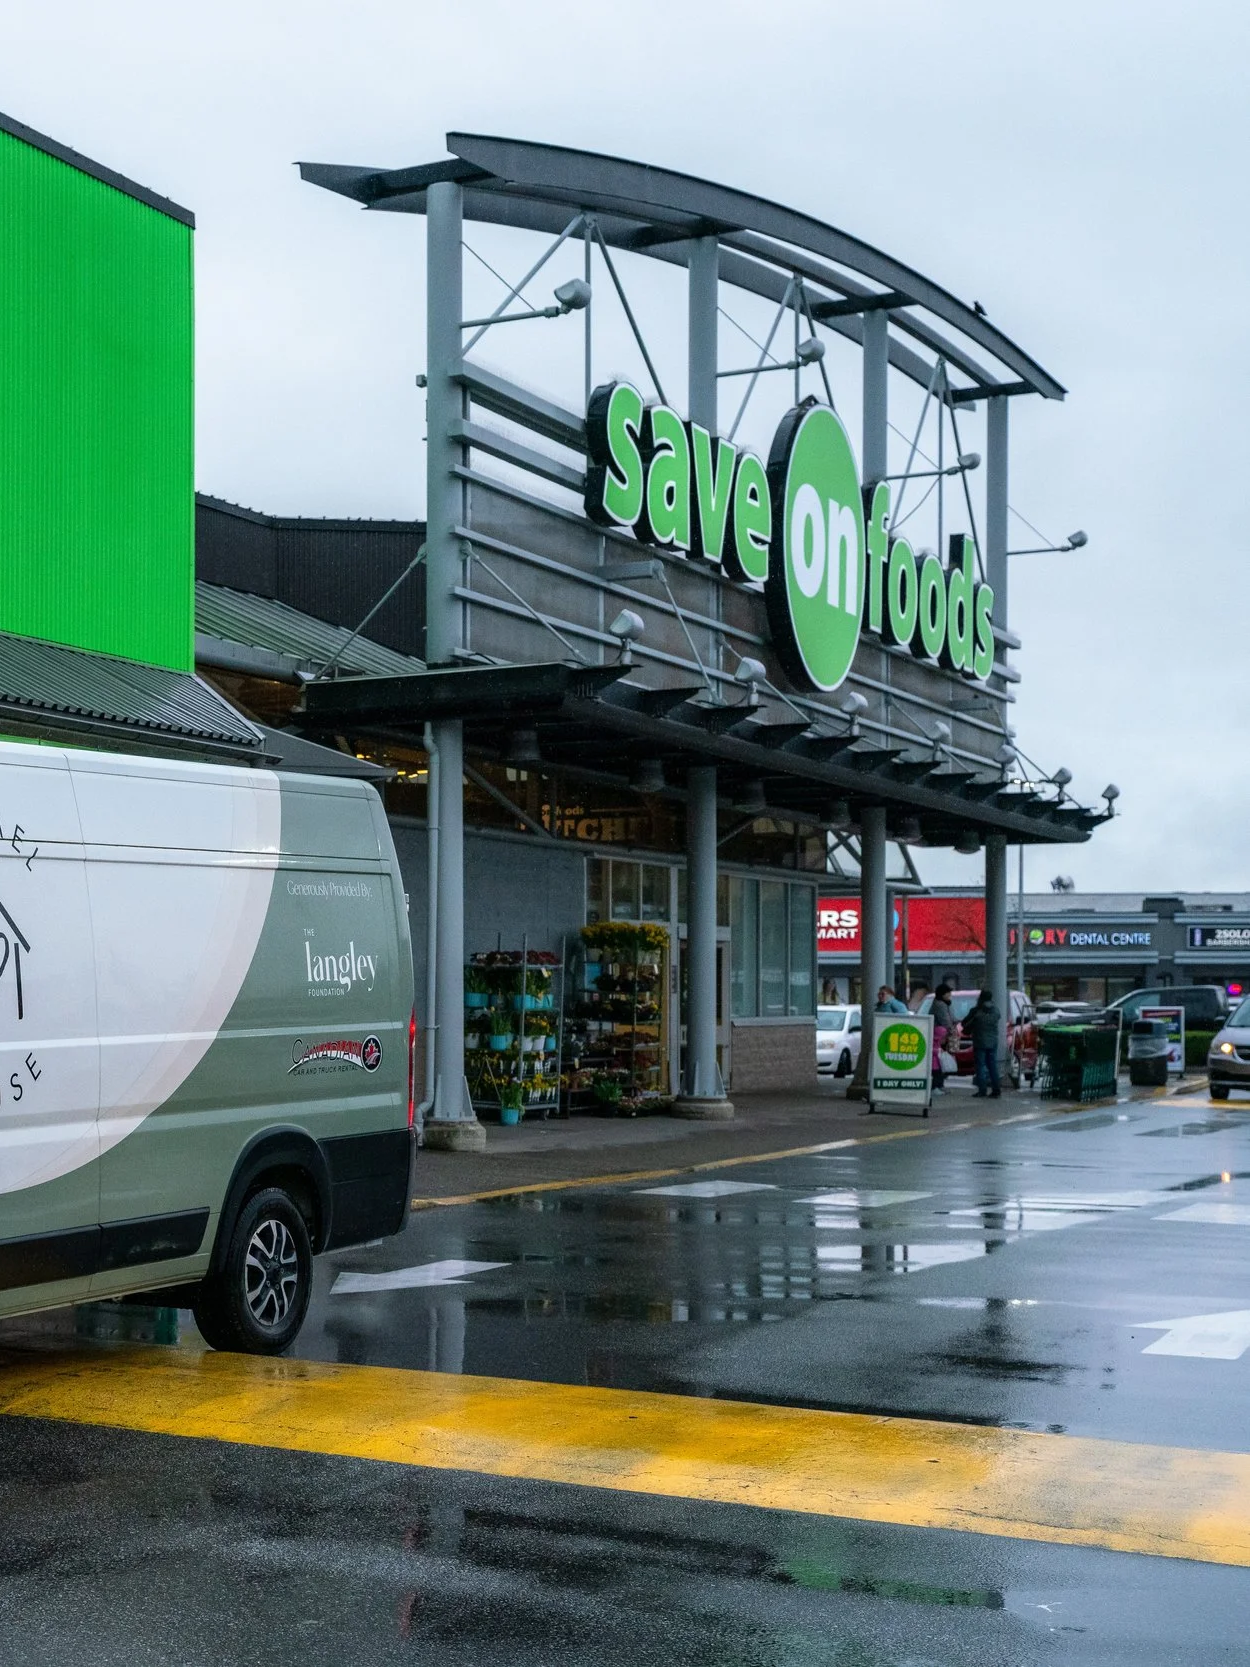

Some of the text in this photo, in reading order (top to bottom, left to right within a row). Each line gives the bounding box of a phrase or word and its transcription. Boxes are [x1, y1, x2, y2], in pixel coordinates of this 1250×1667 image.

[602, 381, 995, 680] save on foods
[286, 880, 373, 901] Generously Provided By:
[817, 910, 859, 928] RS
[303, 928, 315, 937] THE
[1070, 932, 1109, 945] DENTAL
[1111, 932, 1150, 945] CENTRE
[305, 941, 378, 992] langley
[308, 988, 345, 997] FOUNDATION
[292, 1038, 362, 1065] CANADIAN
[900, 1045, 918, 1053] DAY
[884, 1052, 918, 1062] TUESDAY
[293, 1064, 358, 1077] CAR AND TRUCK RENTAL
[882, 1080, 899, 1088] DAY
[901, 1080, 924, 1088] ONLY!
